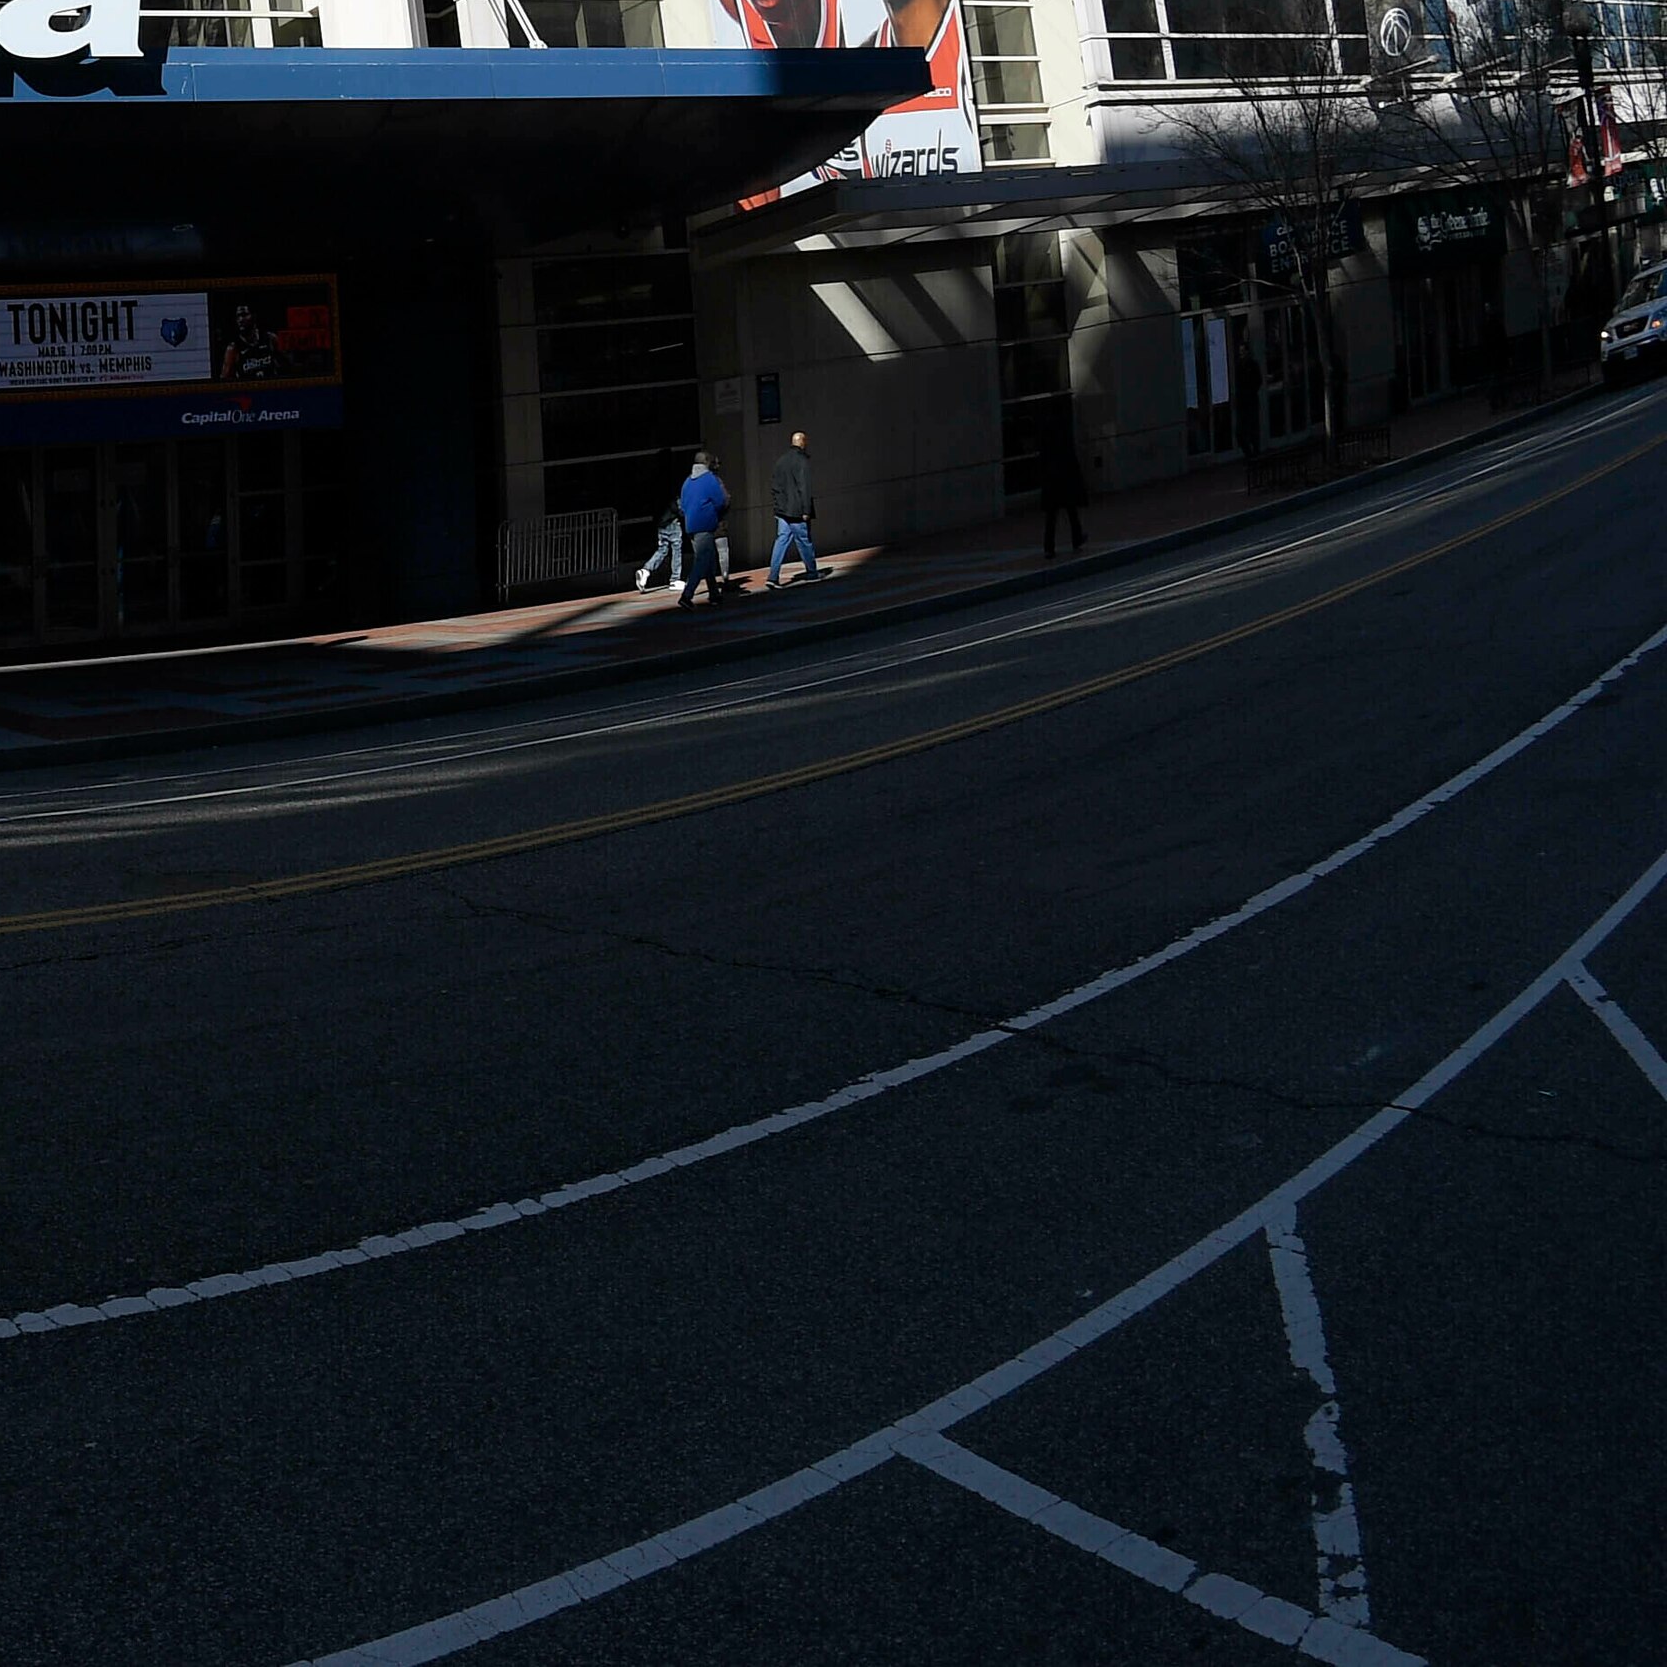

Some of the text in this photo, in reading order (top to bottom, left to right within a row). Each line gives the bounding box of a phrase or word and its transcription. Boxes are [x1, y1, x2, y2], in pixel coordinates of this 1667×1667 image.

[871, 128, 960, 179] wizards
[7, 300, 138, 344] TONIGHT
[99, 356, 152, 373] MEMPHIS
[258, 409, 301, 422] Arena
